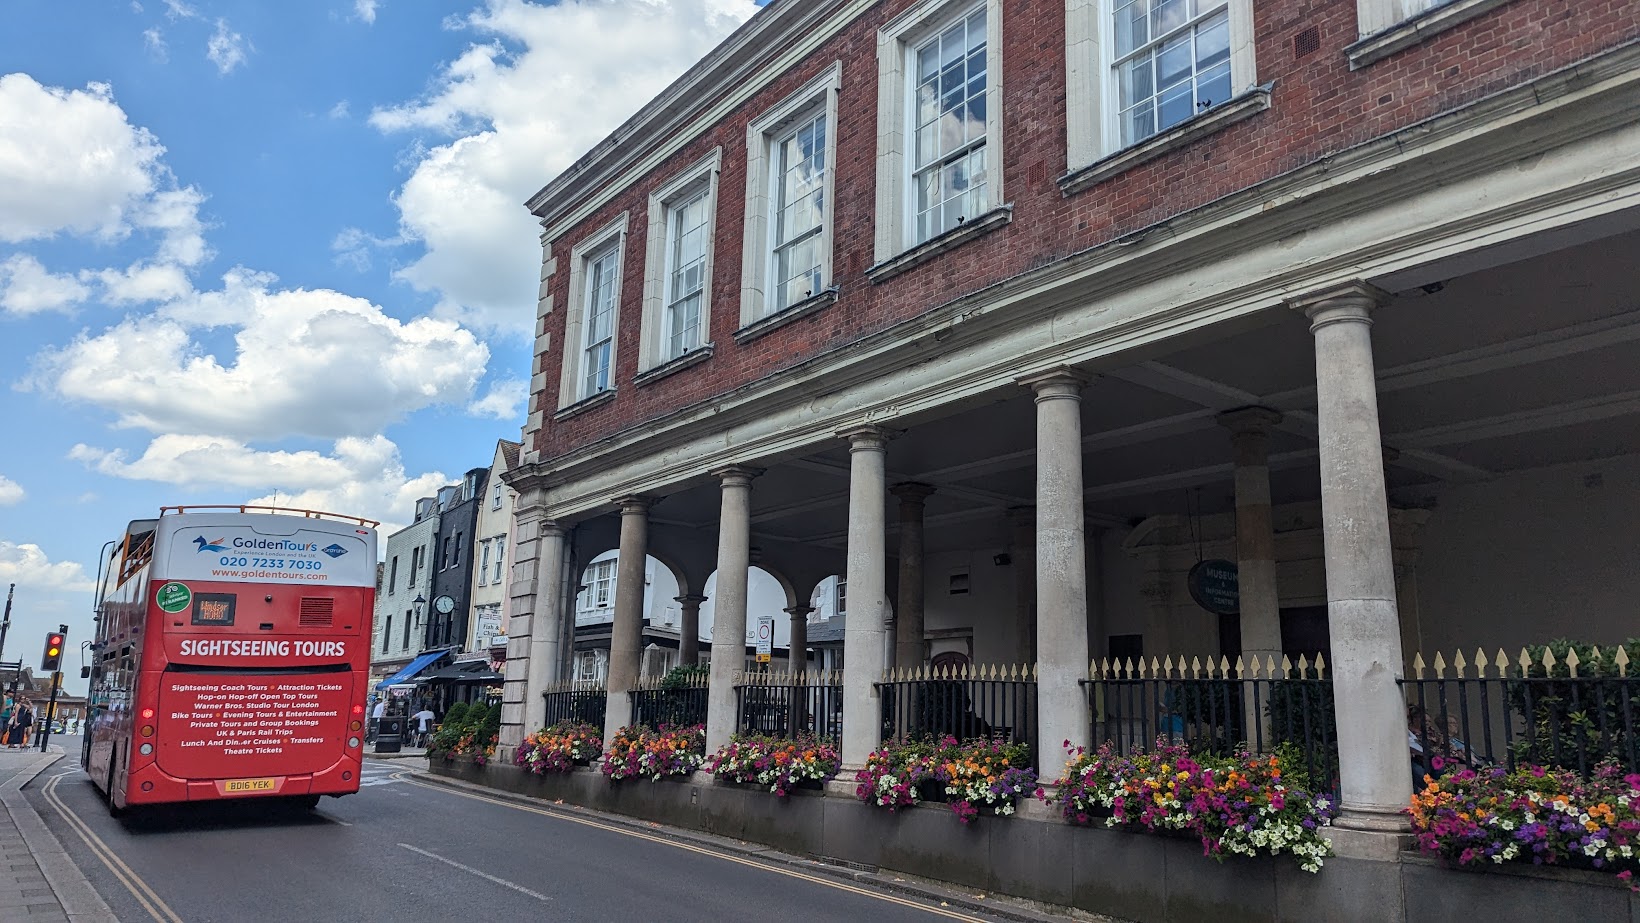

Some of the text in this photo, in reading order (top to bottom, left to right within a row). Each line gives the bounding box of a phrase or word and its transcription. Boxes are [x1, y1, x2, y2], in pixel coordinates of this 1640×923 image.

[232, 537, 318, 552] GoldenTours
[220, 556, 322, 570] 020 7233 7030
[212, 568, 328, 581] www.goldentours.com
[1205, 587, 1240, 598] INFORMATIO
[200, 600, 229, 612] Windsor
[1213, 597, 1234, 606] CENTRE
[180, 639, 346, 657] SIGHTSEEING TOURS
[259, 720, 283, 728] Group
[284, 719, 319, 727] Bookings
[274, 728, 293, 736] Trips
[230, 780, 270, 790] BD16 YEK
